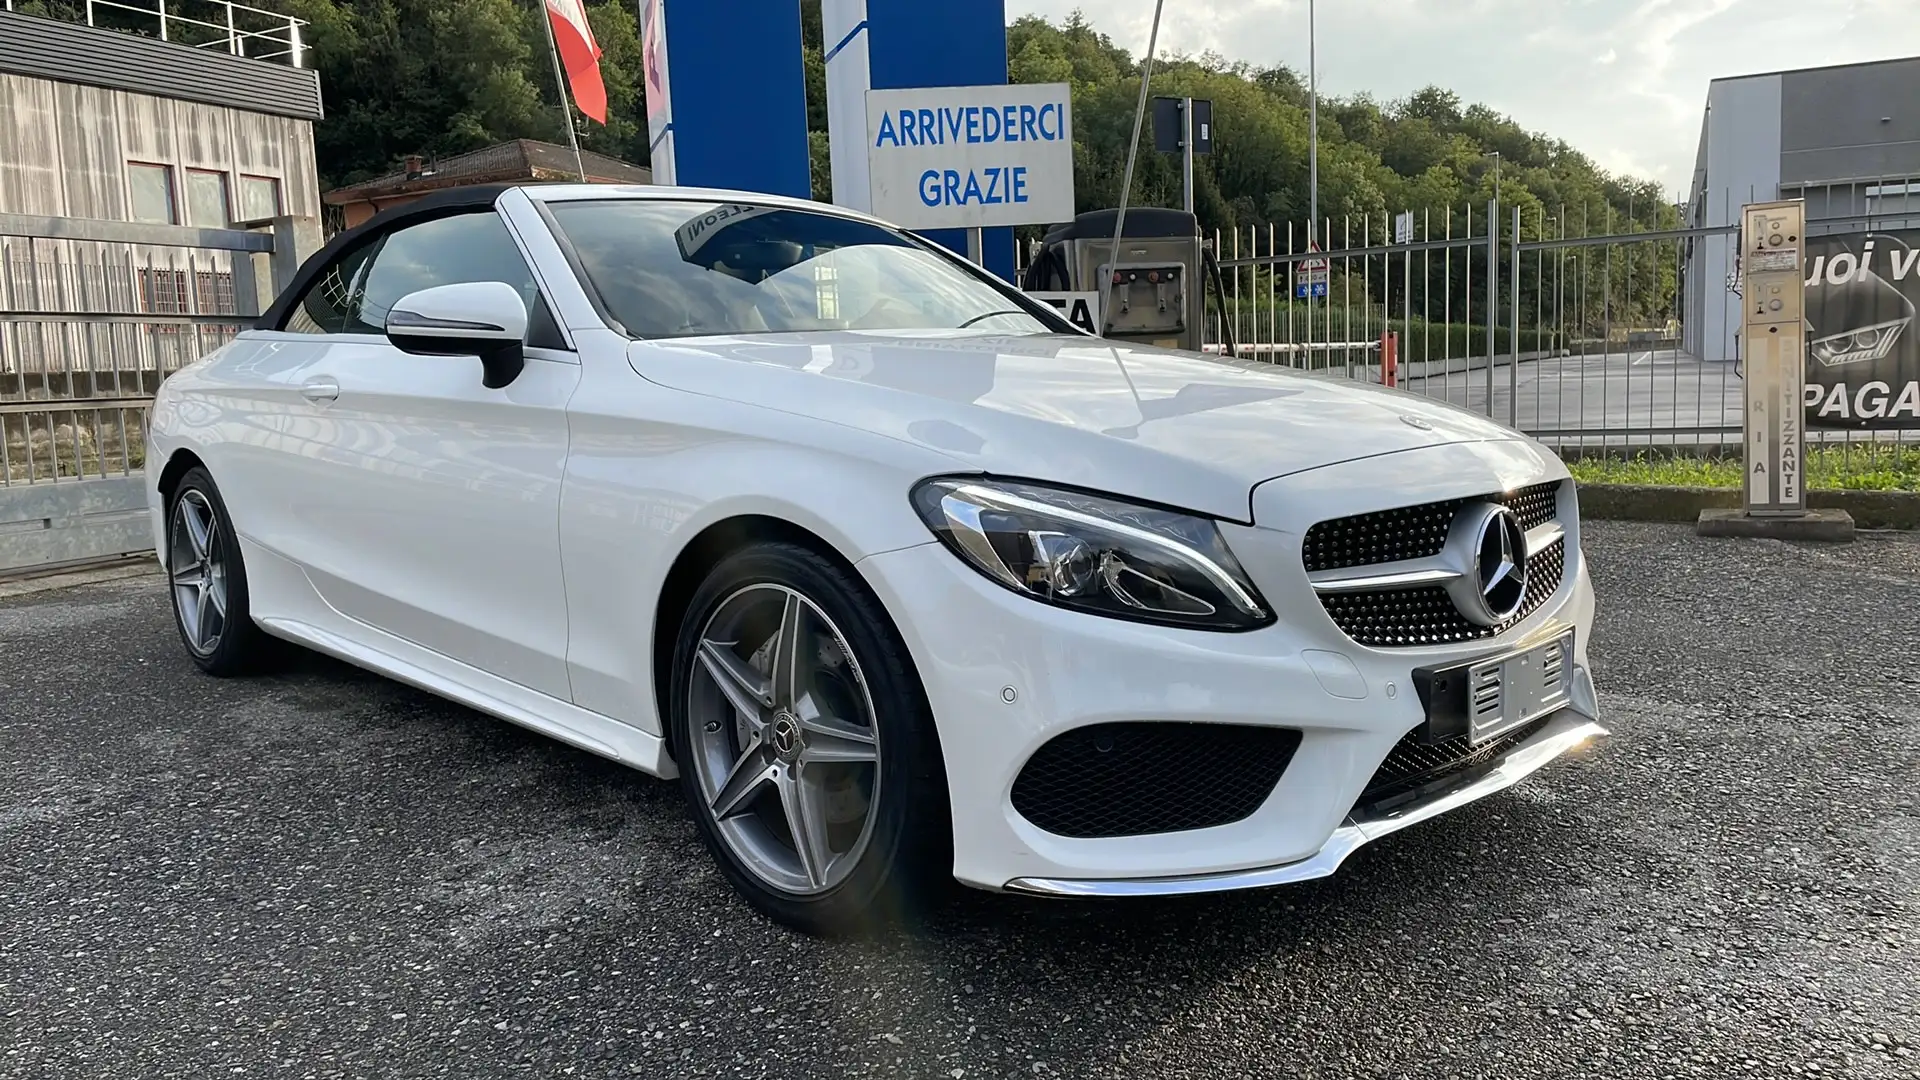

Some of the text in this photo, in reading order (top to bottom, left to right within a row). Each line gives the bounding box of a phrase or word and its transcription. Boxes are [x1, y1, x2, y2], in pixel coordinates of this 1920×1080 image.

[875, 103, 1065, 148] ARRIVEDERCI
[919, 166, 1029, 207] GRAZIE
[1889, 249, 1920, 282] v
[1804, 380, 1920, 420] PAGA
